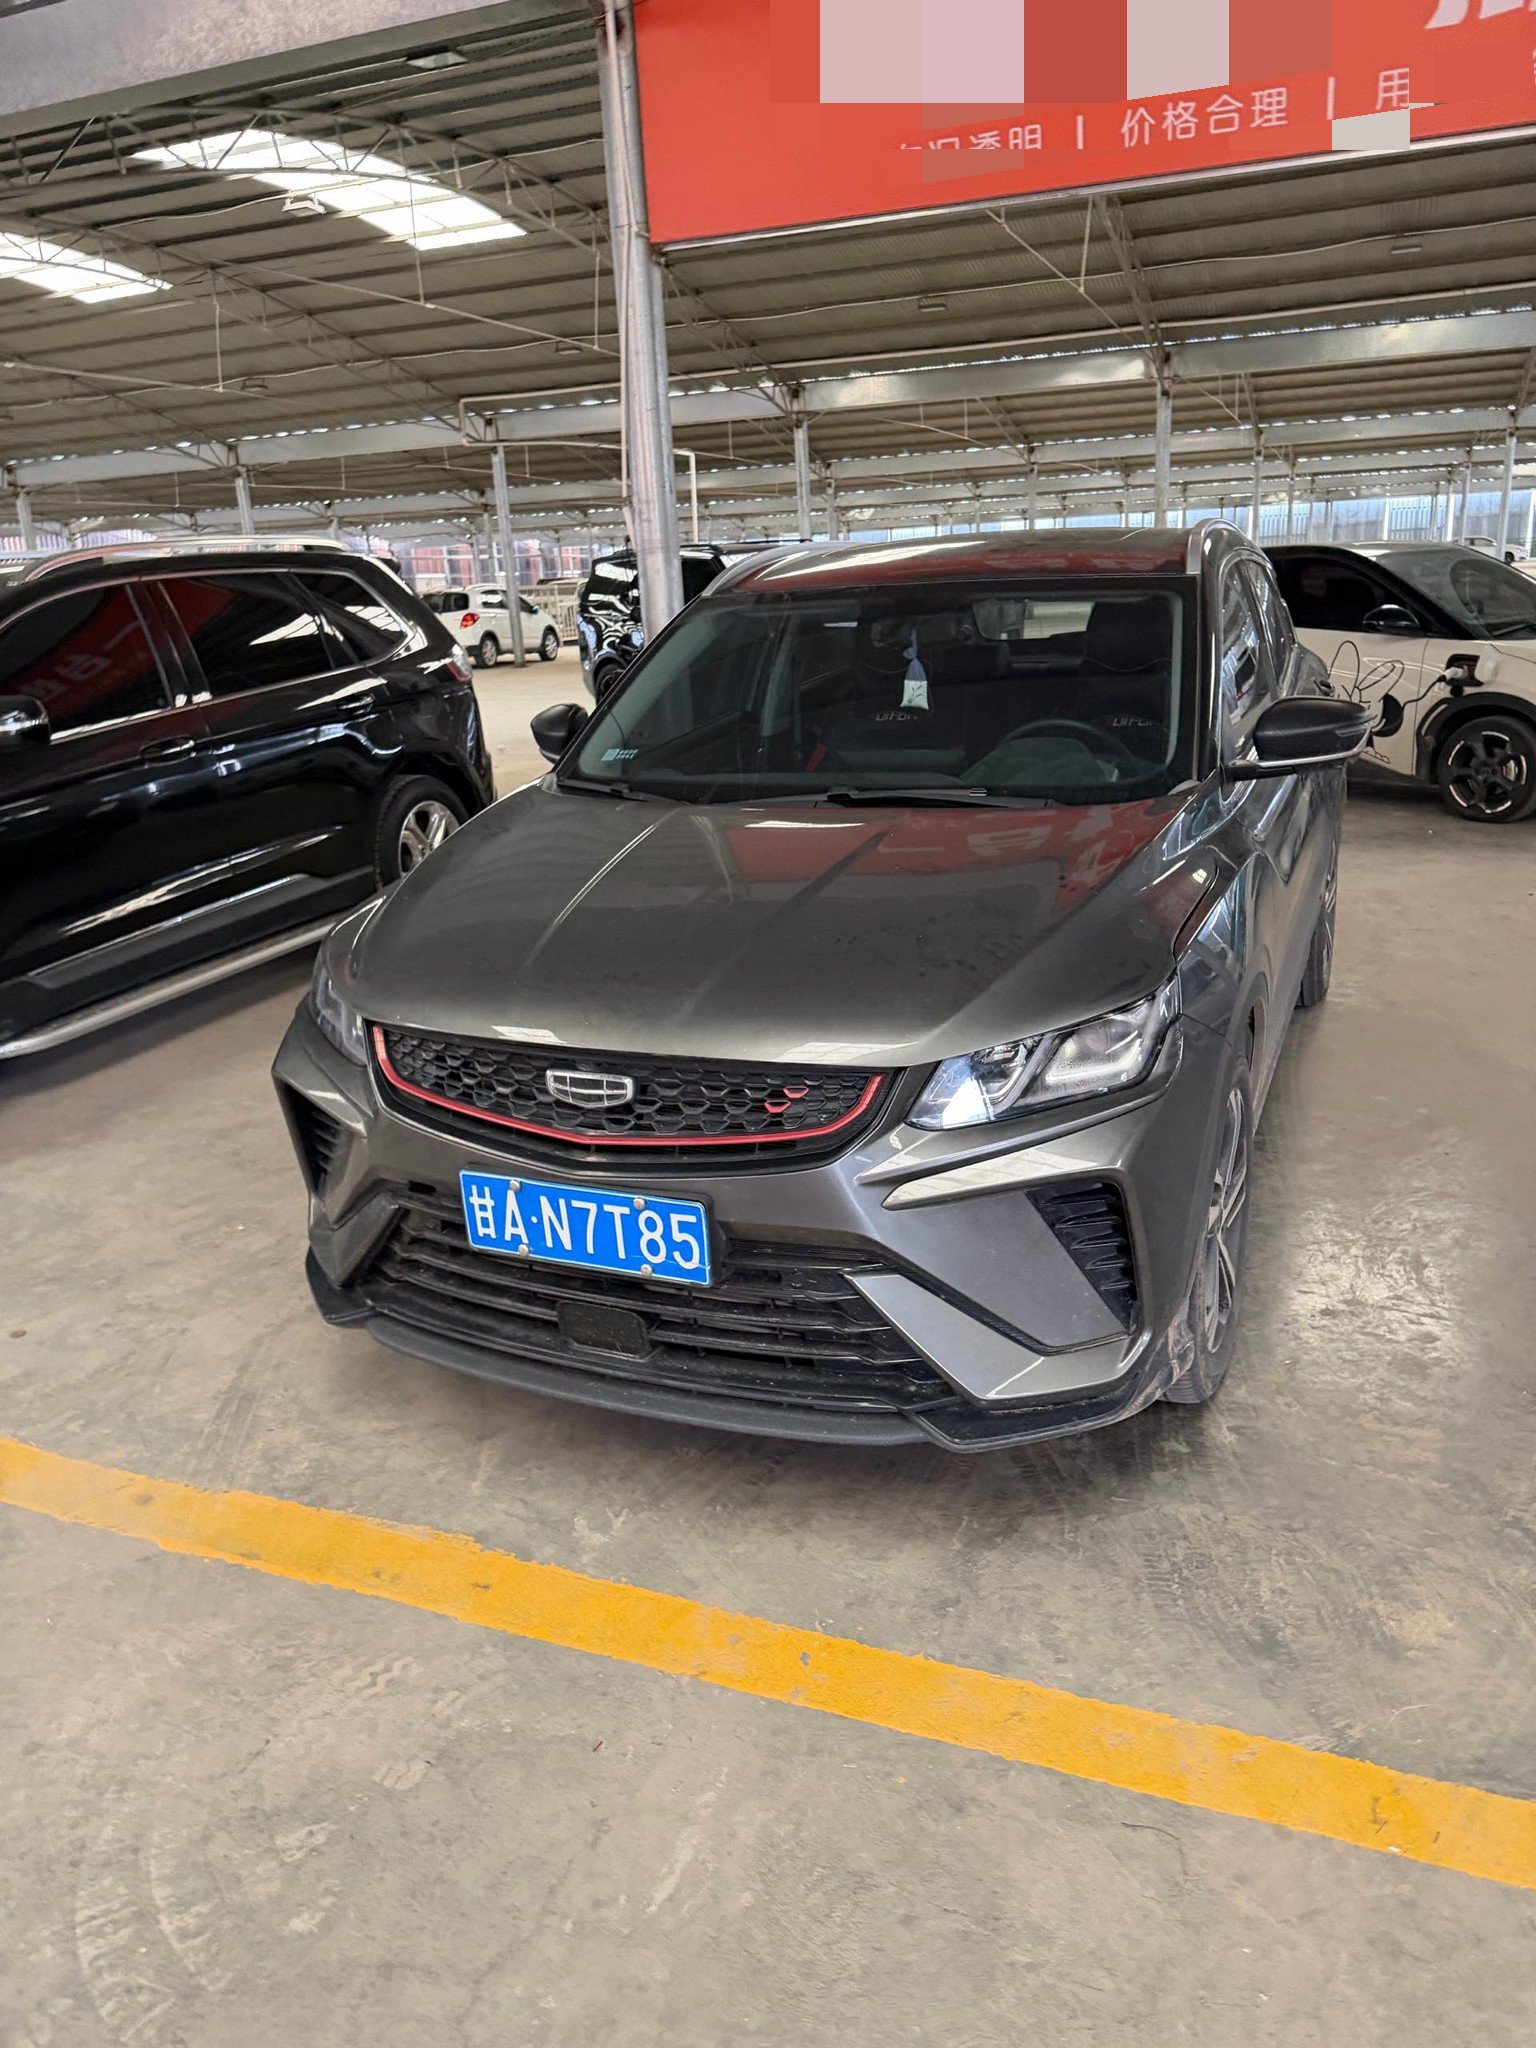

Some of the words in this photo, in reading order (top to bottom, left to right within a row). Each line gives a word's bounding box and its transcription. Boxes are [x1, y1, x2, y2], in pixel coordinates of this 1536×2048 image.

[1120, 86, 1288, 148] 价格合理
[469, 1184, 700, 1270] 甘A·N7T85
